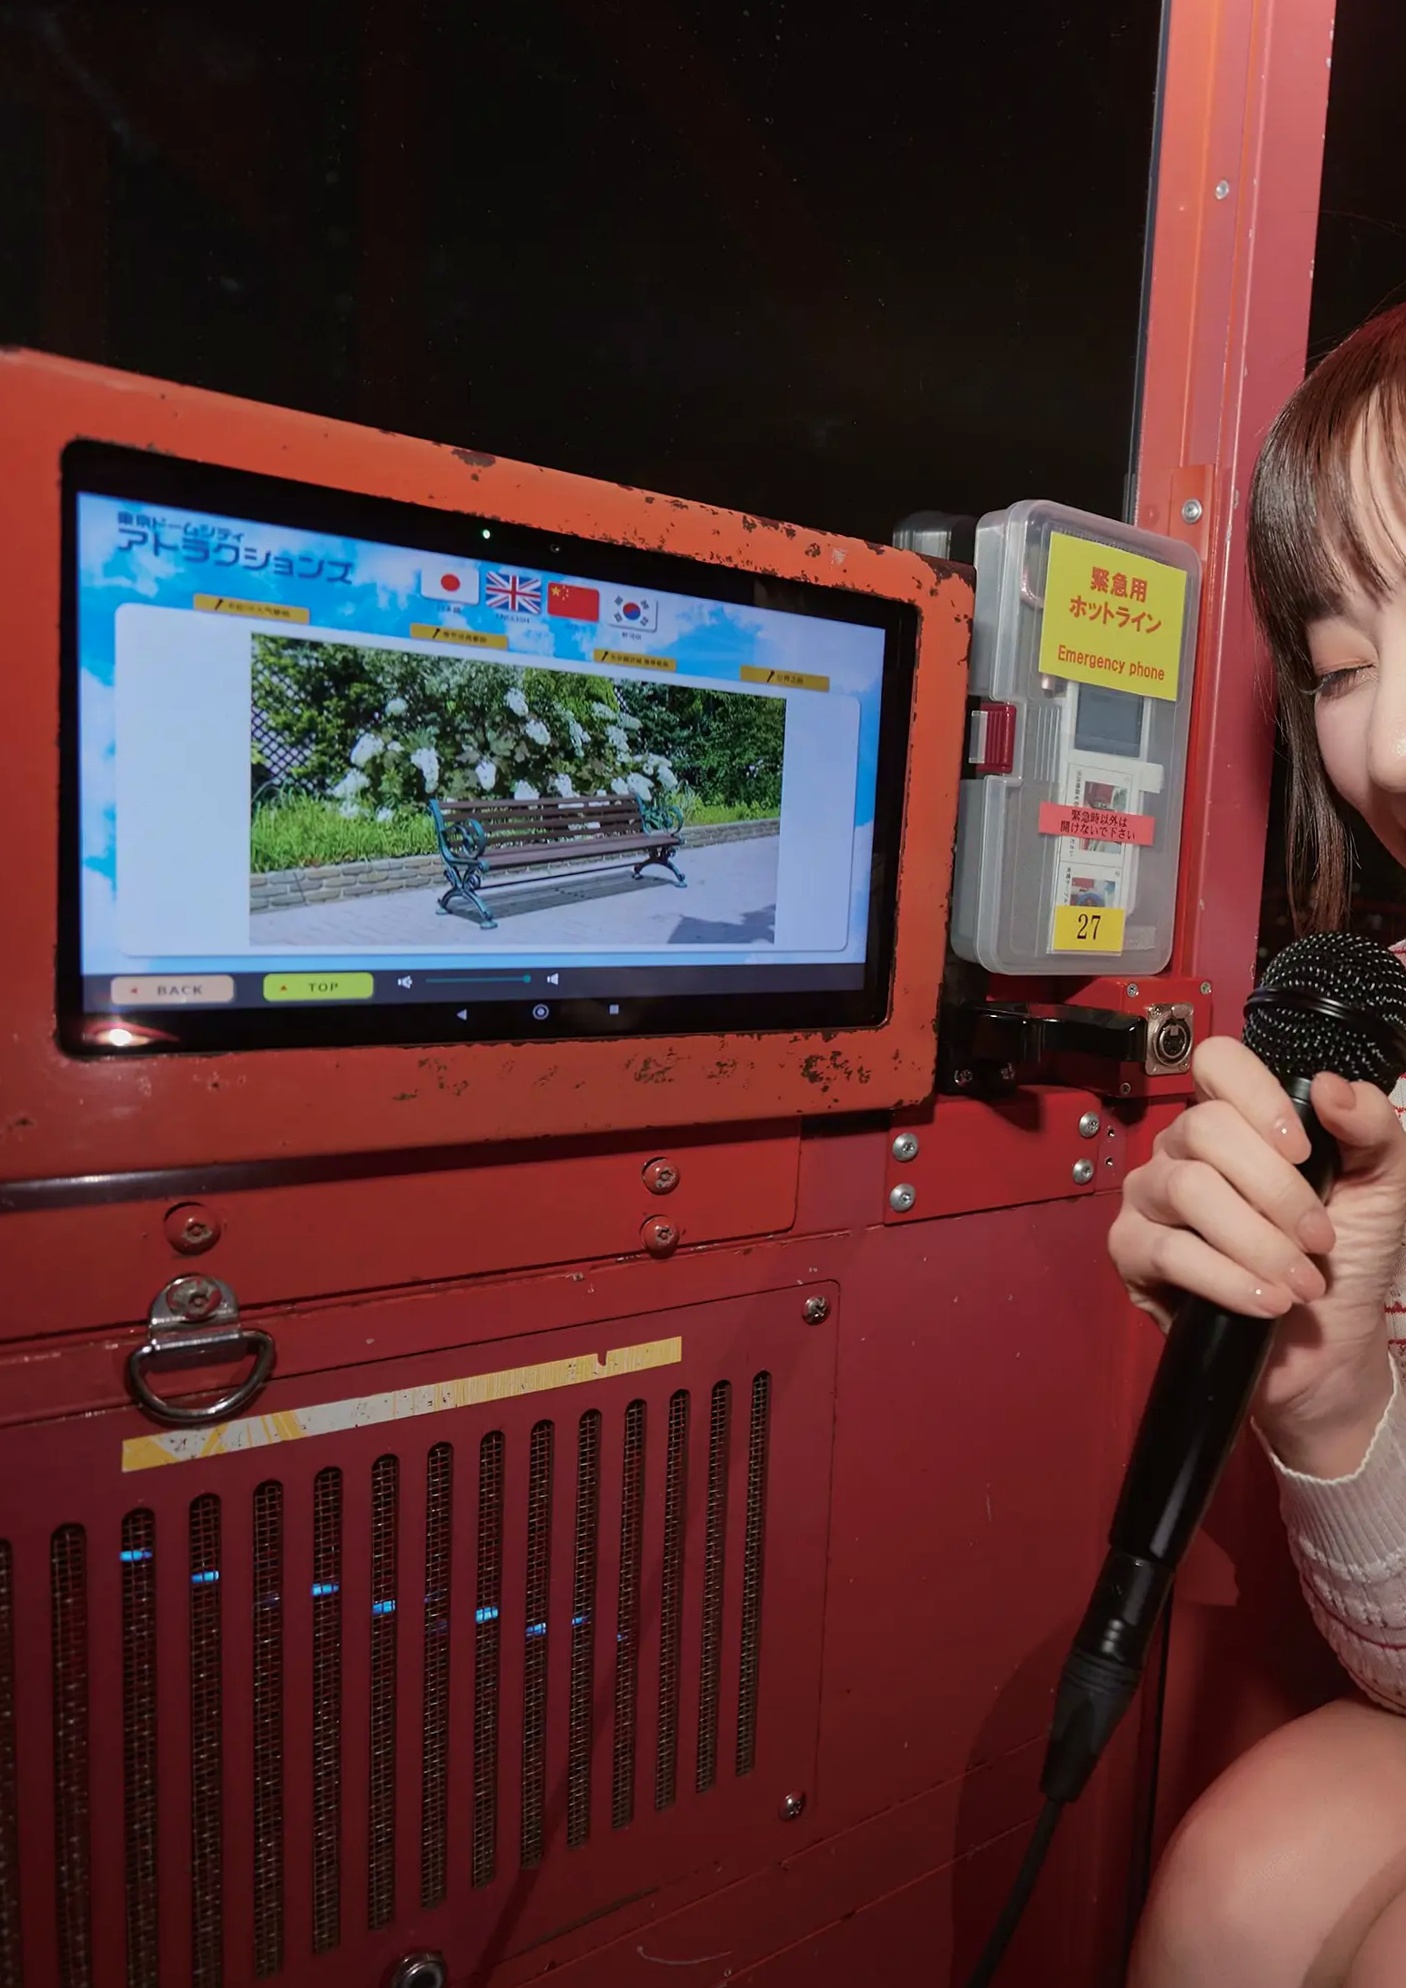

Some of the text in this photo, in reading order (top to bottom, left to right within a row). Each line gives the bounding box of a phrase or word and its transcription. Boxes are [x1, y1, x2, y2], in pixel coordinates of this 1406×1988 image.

[1090, 566, 1148, 603] 緊急用
[1069, 595, 1162, 634] ホットライン
[1058, 644, 1165, 681] Emergency phone
[1060, 820, 1136, 840] 開けないで下さい
[1071, 809, 1128, 828] 緊急時以外は
[1076, 913, 1102, 940] 27
[157, 984, 204, 996] BACK
[308, 982, 339, 992] TOP
